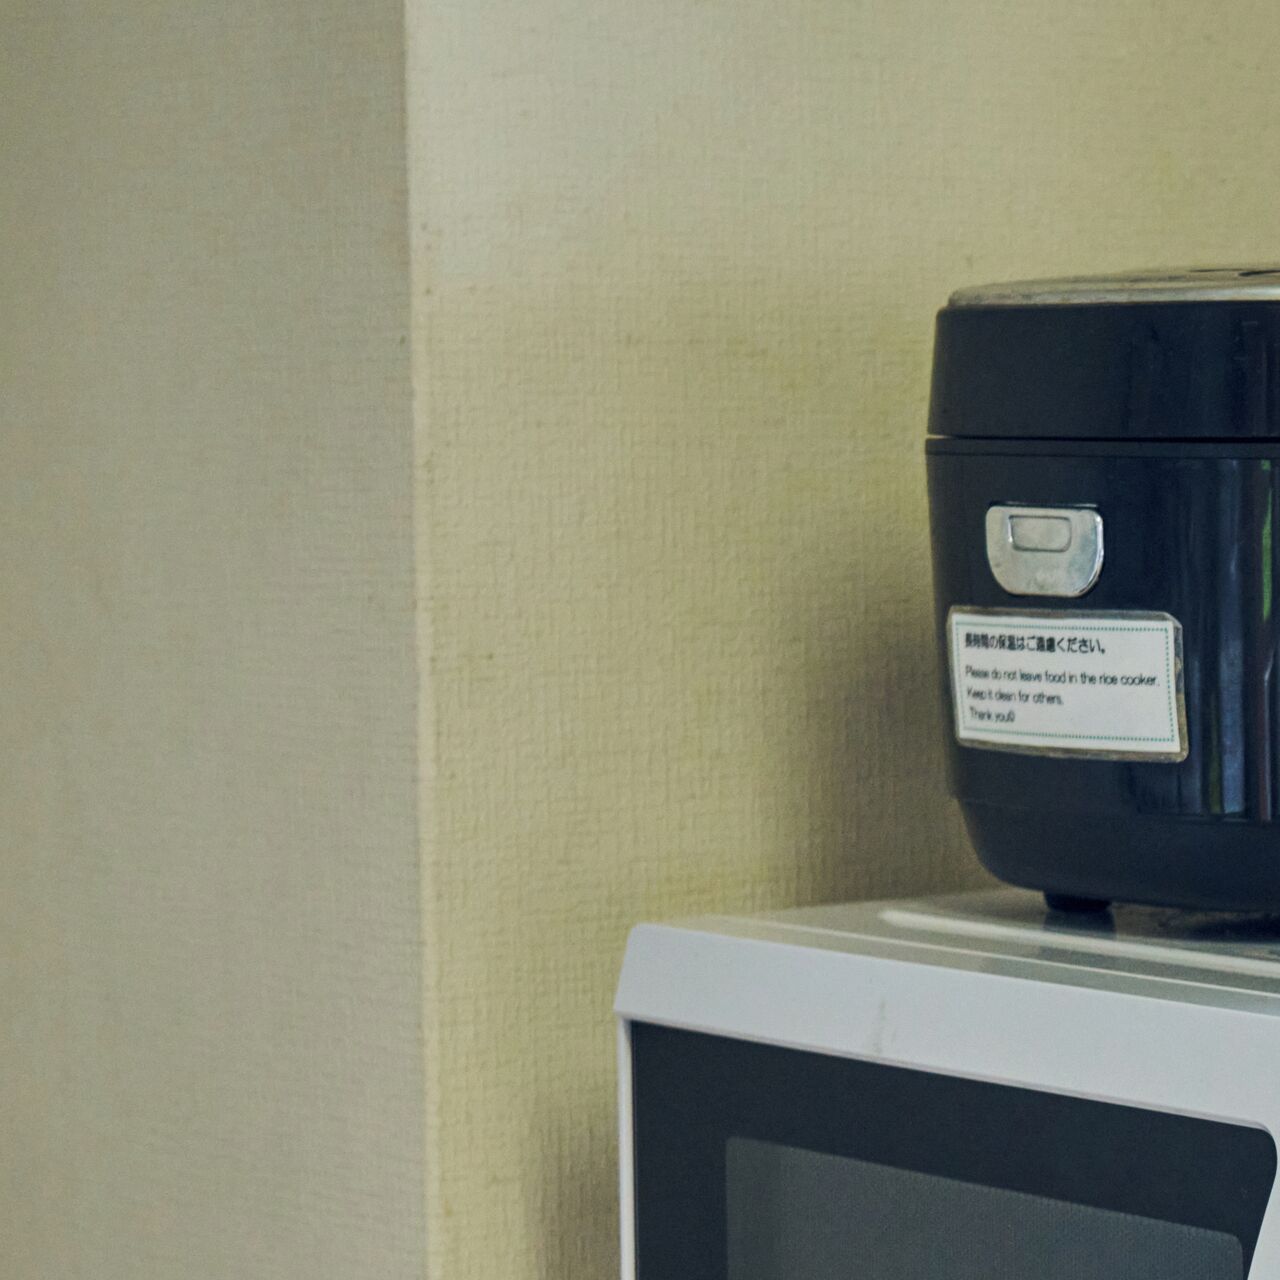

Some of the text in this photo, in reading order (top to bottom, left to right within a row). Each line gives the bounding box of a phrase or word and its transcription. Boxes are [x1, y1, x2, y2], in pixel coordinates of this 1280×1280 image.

[965, 665, 1160, 687] Please do not leave food in the rice cooker.
[994, 689, 1016, 702] clean
[1018, 690, 1030, 703] for
[969, 706, 992, 721] Thank
